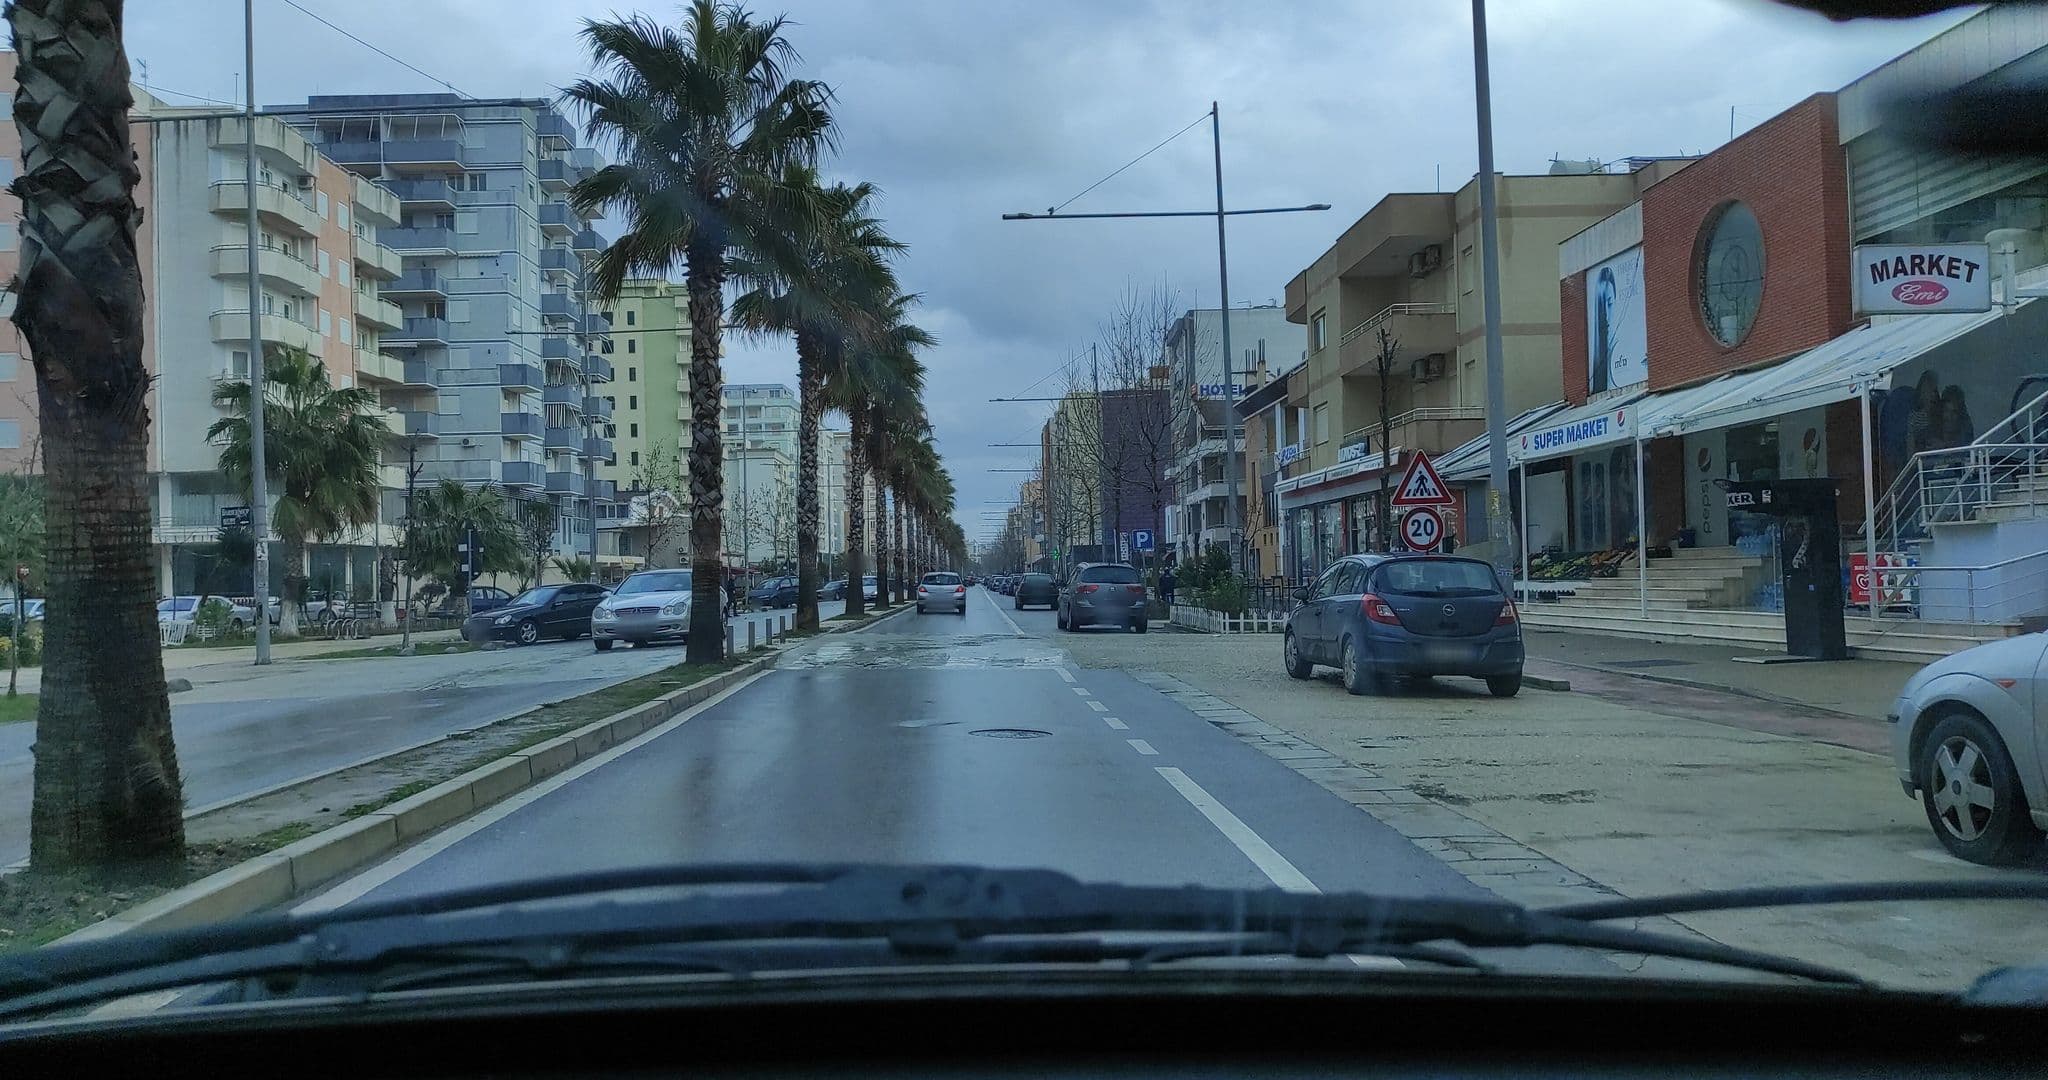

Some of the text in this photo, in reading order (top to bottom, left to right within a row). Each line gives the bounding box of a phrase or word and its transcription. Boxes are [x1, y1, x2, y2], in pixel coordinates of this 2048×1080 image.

[1870, 254, 1980, 285] MARKET
[1899, 284, 1946, 301] Emi
[1533, 416, 1609, 451] SUPER MARKET
[1411, 518, 1435, 537] 20
[1136, 531, 1149, 548] P
